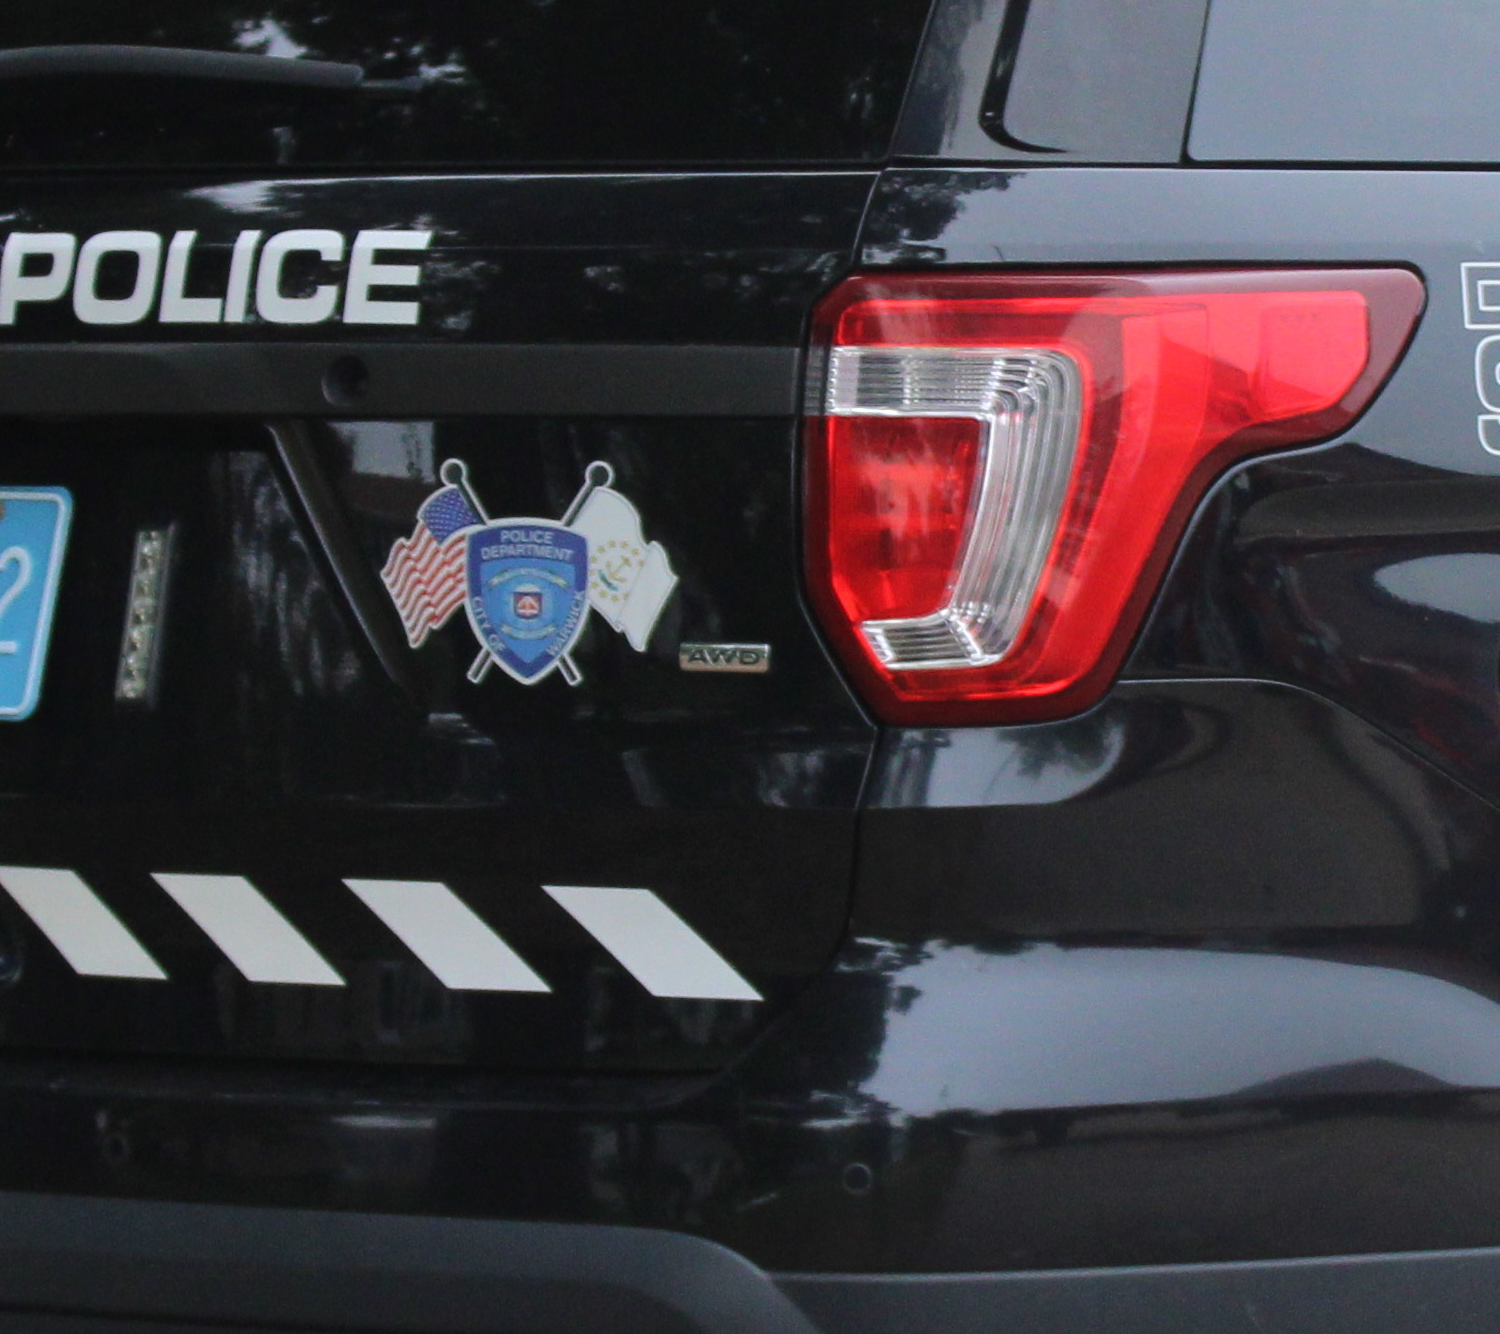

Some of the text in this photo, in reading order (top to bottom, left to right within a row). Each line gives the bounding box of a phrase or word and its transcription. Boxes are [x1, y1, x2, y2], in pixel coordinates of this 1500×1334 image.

[500, 530, 554, 546] POLICE
[480, 544, 575, 563] DEPARTMENT
[472, 596, 506, 653] CITY OF
[546, 589, 586, 657] WARWICK
[687, 648, 761, 666] AWD
